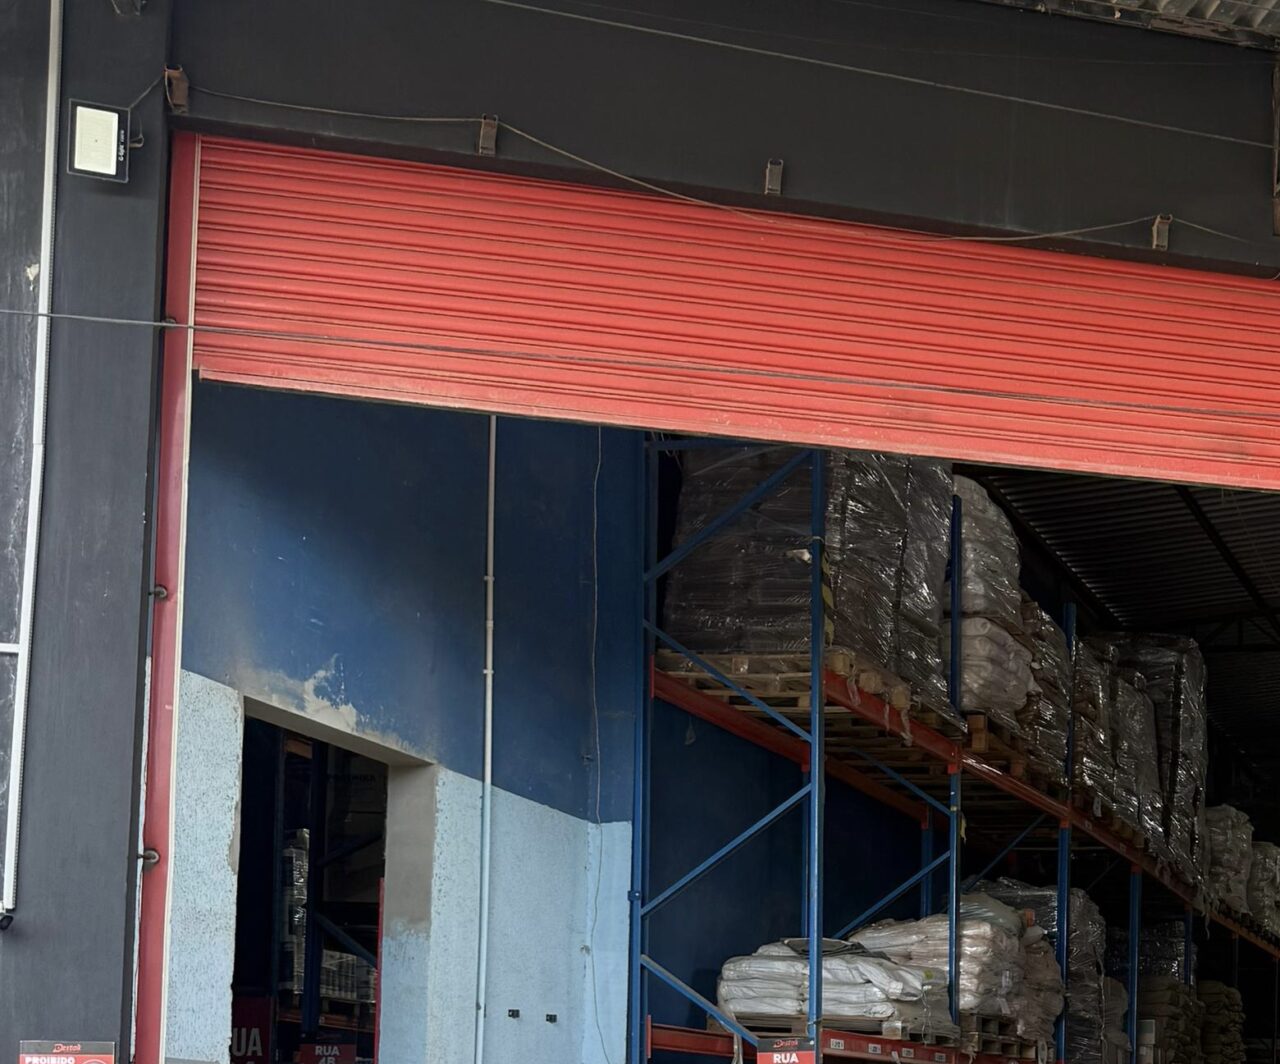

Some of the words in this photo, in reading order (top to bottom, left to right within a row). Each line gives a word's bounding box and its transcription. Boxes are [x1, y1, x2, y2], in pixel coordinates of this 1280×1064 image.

[232, 1027, 262, 1056] UA
[315, 1045, 340, 1056] RUA
[25, 1056, 75, 1064] PROIBIDO
[773, 1053, 799, 1063] RUA
